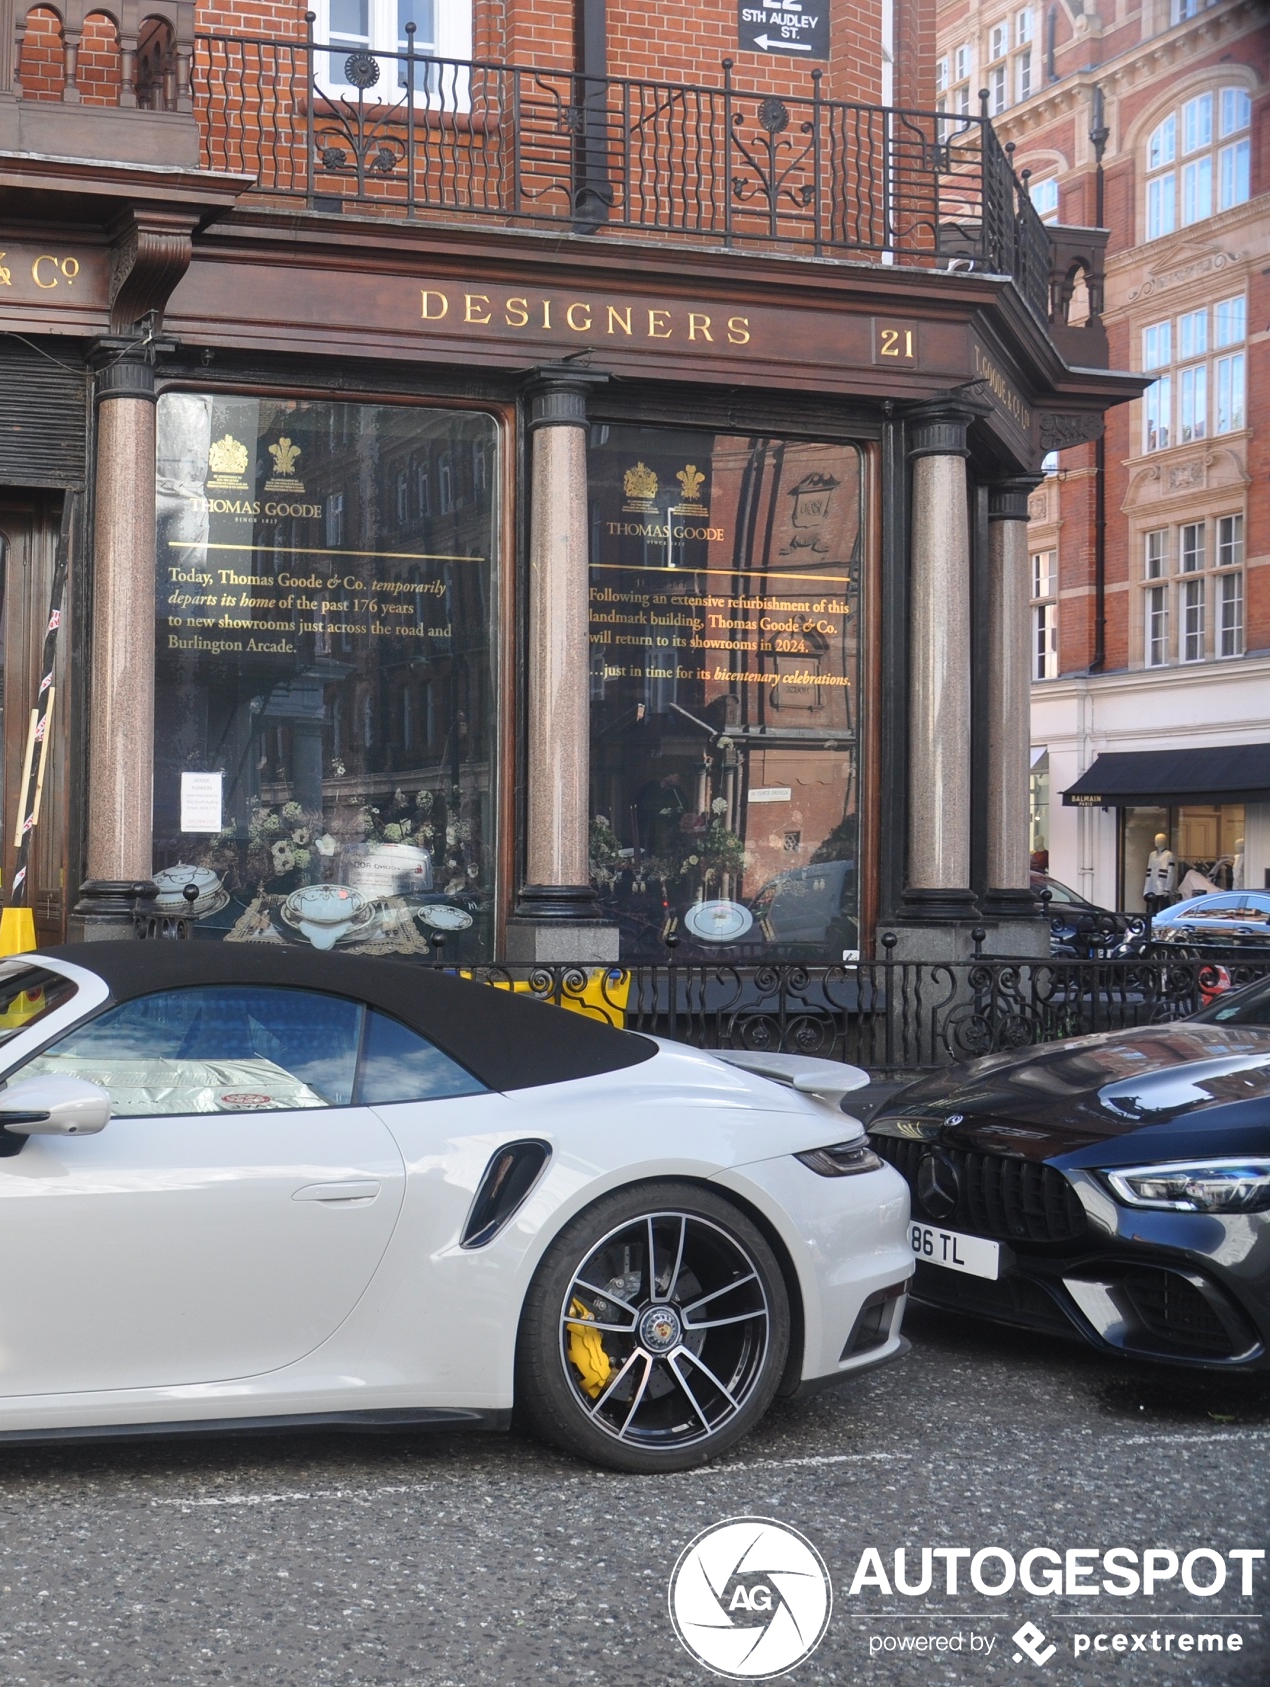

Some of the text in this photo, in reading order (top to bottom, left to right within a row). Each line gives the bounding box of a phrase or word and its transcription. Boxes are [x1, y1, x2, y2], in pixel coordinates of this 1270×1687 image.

[742, 8, 819, 29] STH AUDLEY
[781, 26, 800, 39] ST.
[420, 289, 751, 345] DESIGNERS
[880, 329, 914, 358] 21
[189, 498, 322, 518] THOMAS GOODE
[607, 522, 724, 542] THOMAS GOODE
[168, 567, 447, 597] Today, Thomas Goode & Co. temporarily
[168, 591, 415, 616] departs its home of the past 176 years
[589, 587, 850, 614] Following an extensive refurbishment of this
[168, 616, 453, 638] to new showrooms just across the road and
[589, 609, 838, 634] landmark building, Thomas Goode & Co.
[168, 634, 297, 654] Burlington Arcade.
[589, 630, 809, 653] will return to its showrooms in 2024.
[630, 666, 642, 677] in
[645, 666, 673, 678] time
[676, 666, 693, 679] for
[696, 668, 711, 680] its
[714, 667, 780, 687] bicentenary
[782, 672, 851, 686] celebrations.
[911, 1226, 965, 1266] 86 TL
